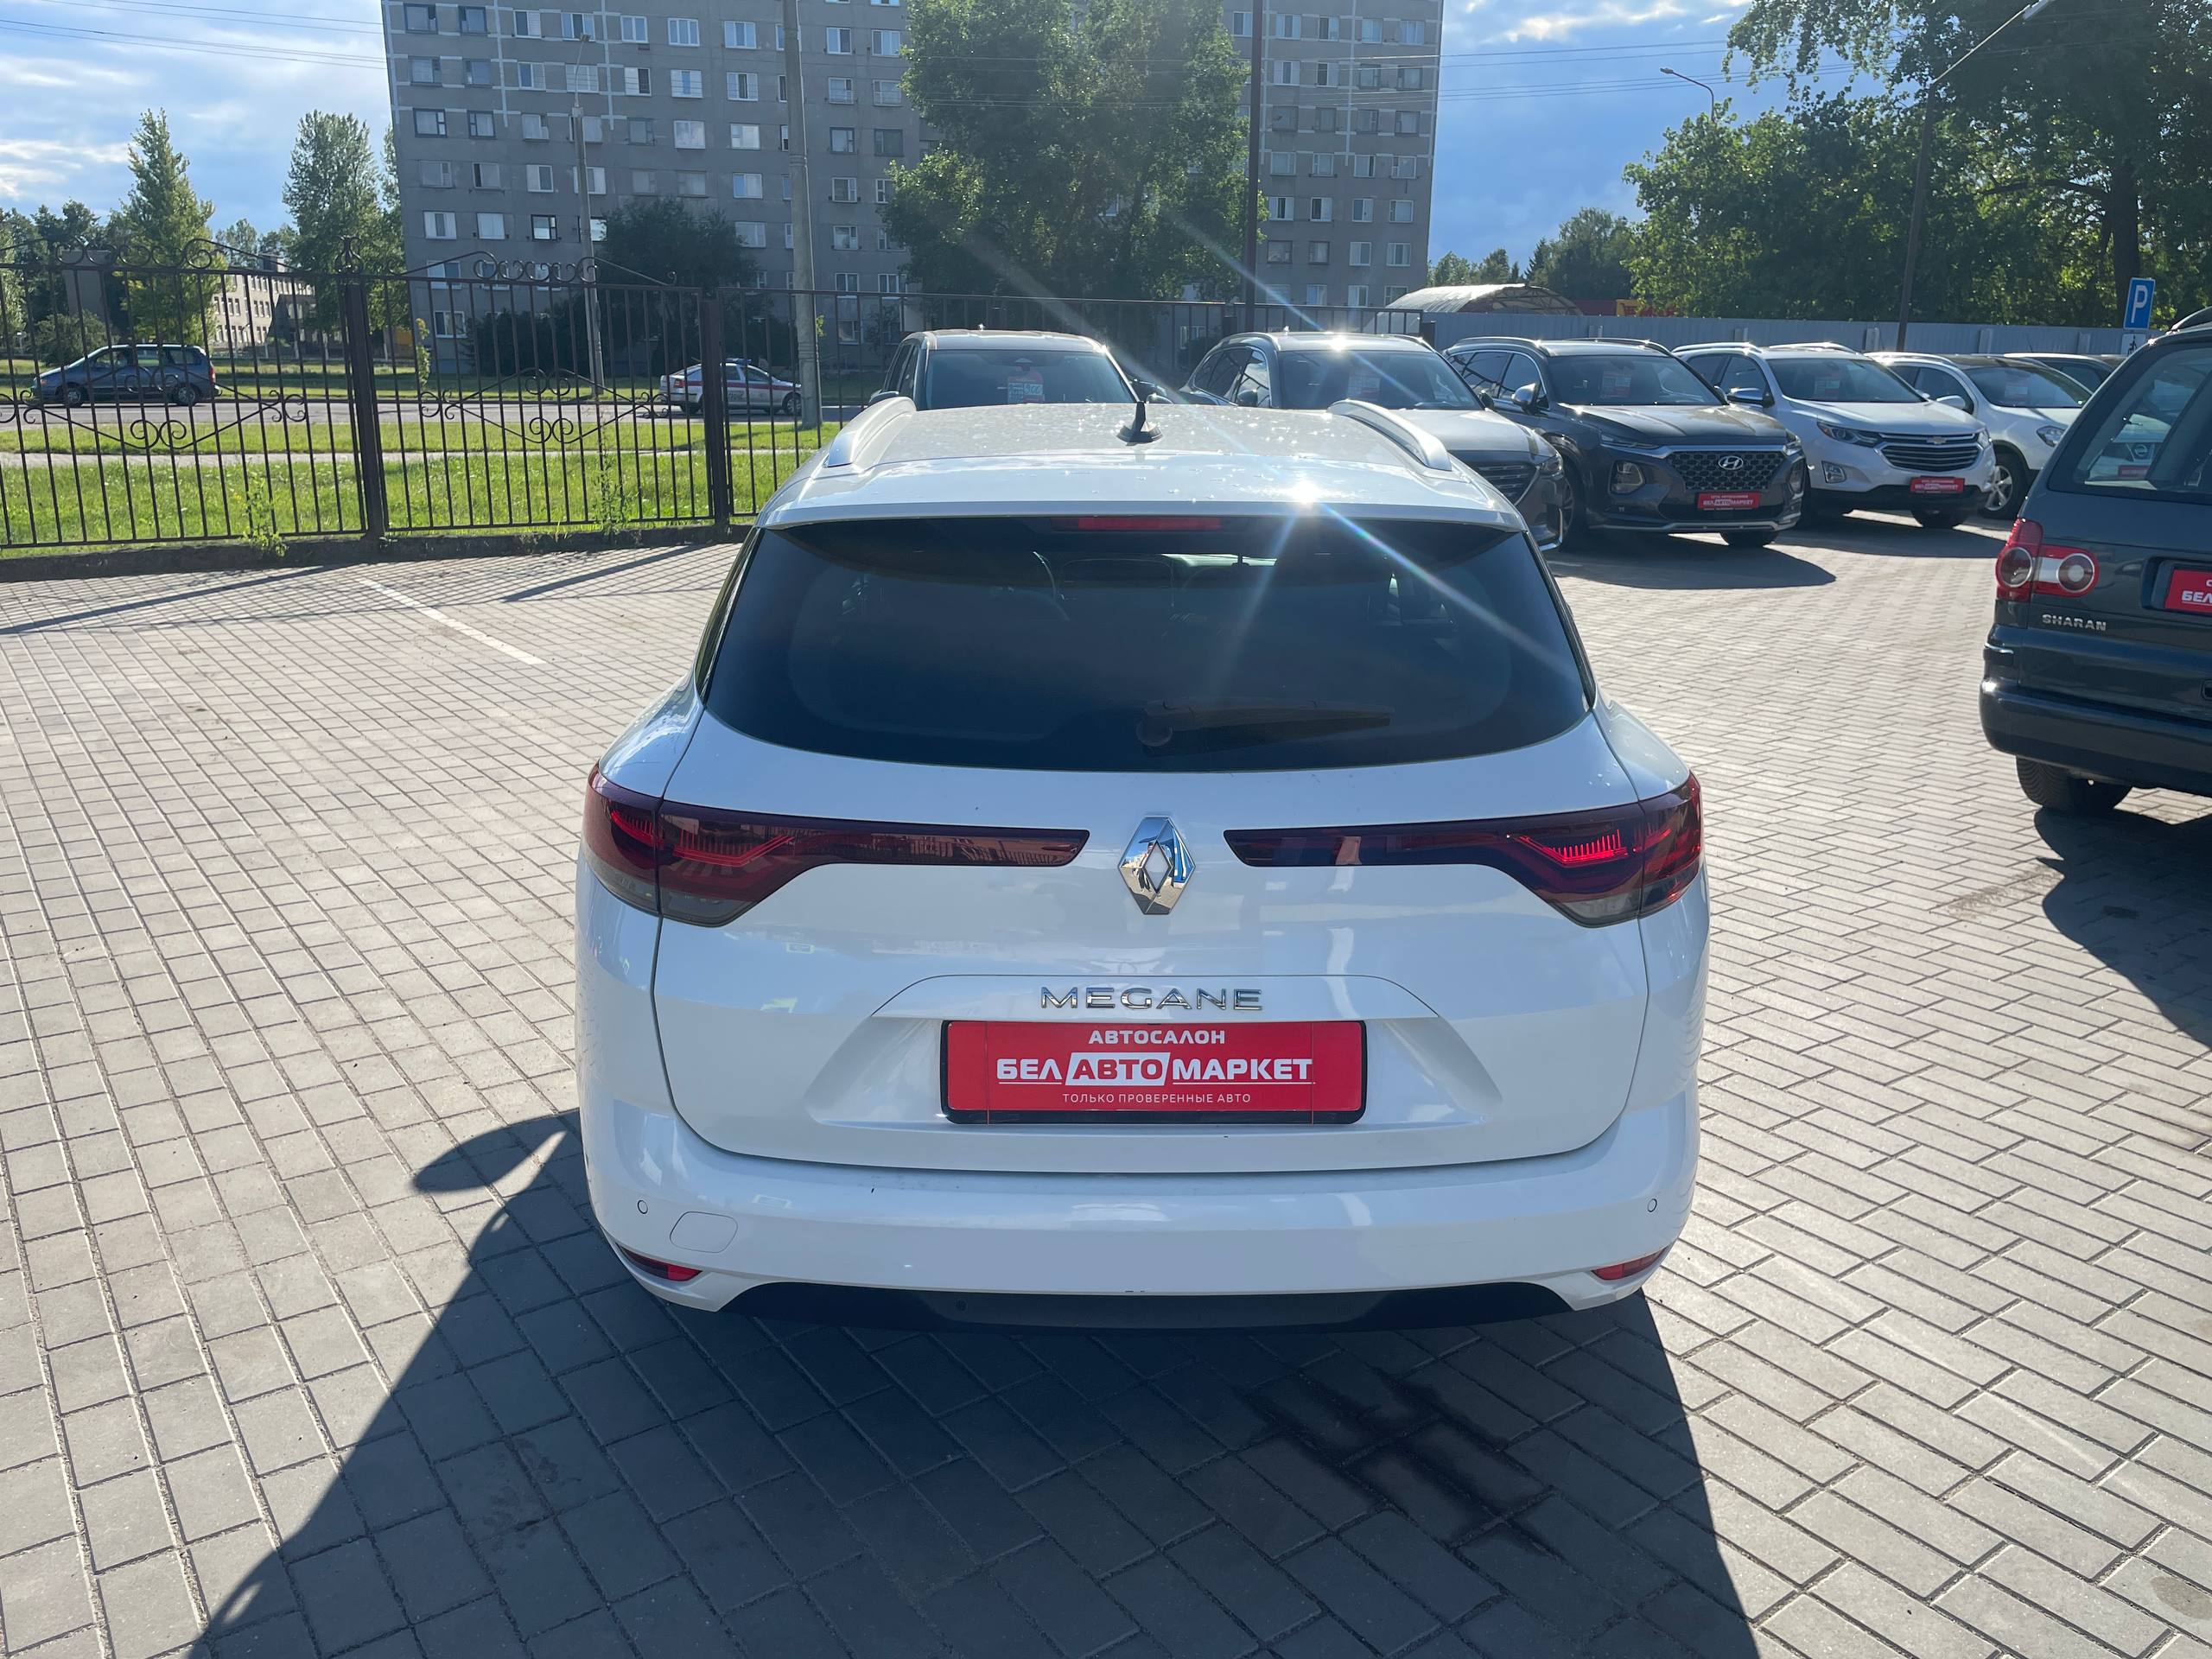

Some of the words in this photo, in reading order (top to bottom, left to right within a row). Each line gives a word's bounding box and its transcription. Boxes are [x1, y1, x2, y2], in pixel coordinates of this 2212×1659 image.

[2131, 284, 2148, 323] P
[2042, 613, 2107, 632] SHARAN
[1040, 987, 1262, 1011] MEGANE
[1088, 1029, 1225, 1045] АВТОСАЛОН
[1063, 1093, 1115, 1103] ТОЛЬКО
[1118, 1093, 1214, 1103] ПРОВЕРЕННЫЕ
[1217, 1093, 1251, 1103] АВТО
